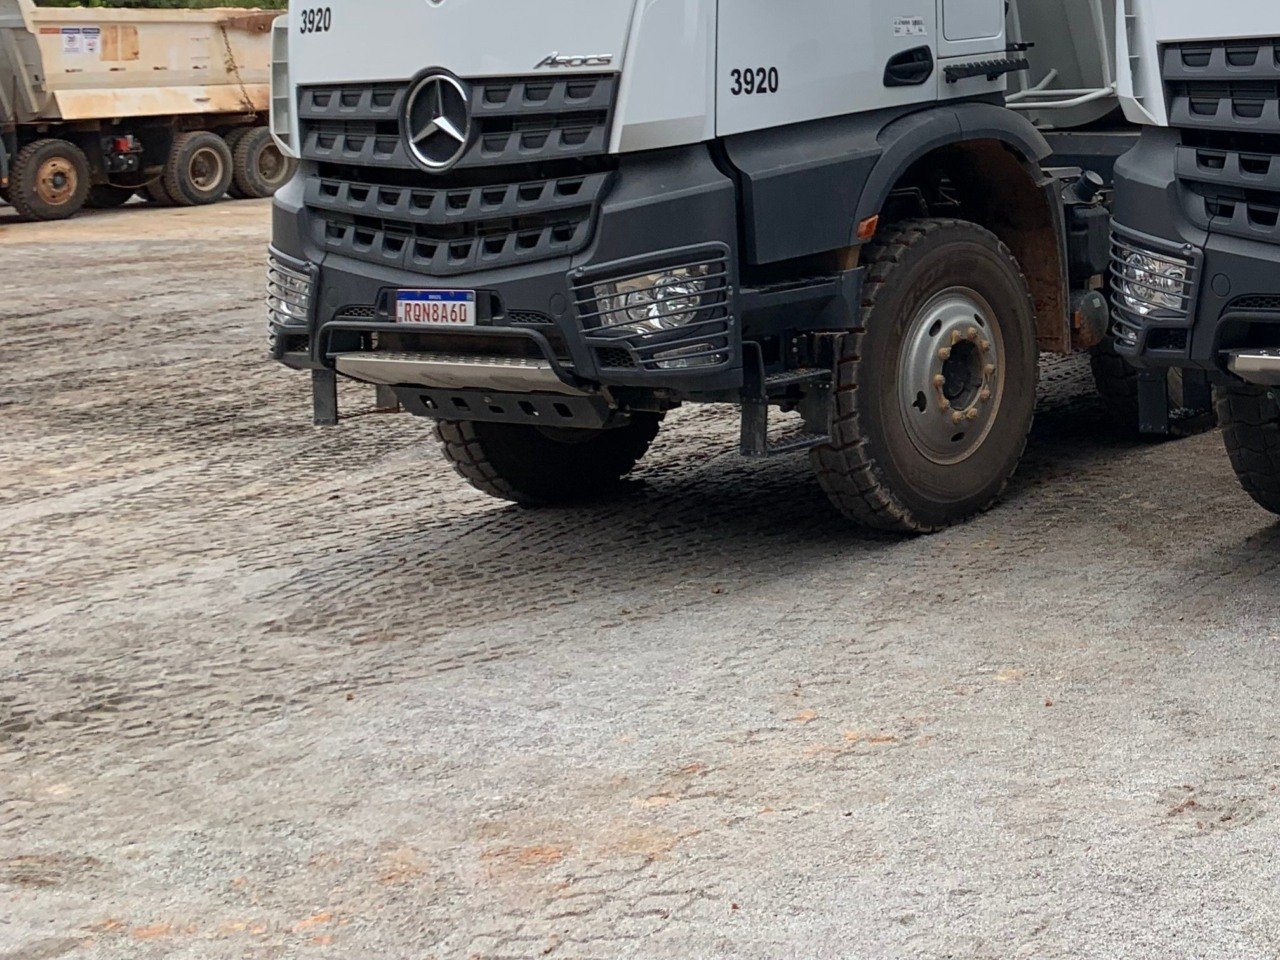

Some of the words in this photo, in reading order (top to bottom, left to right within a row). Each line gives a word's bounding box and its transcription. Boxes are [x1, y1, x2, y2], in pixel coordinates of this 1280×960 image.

[300, 6, 332, 34] 3920
[730, 66, 779, 95] 3920
[404, 302, 467, 323] RQN8A60
